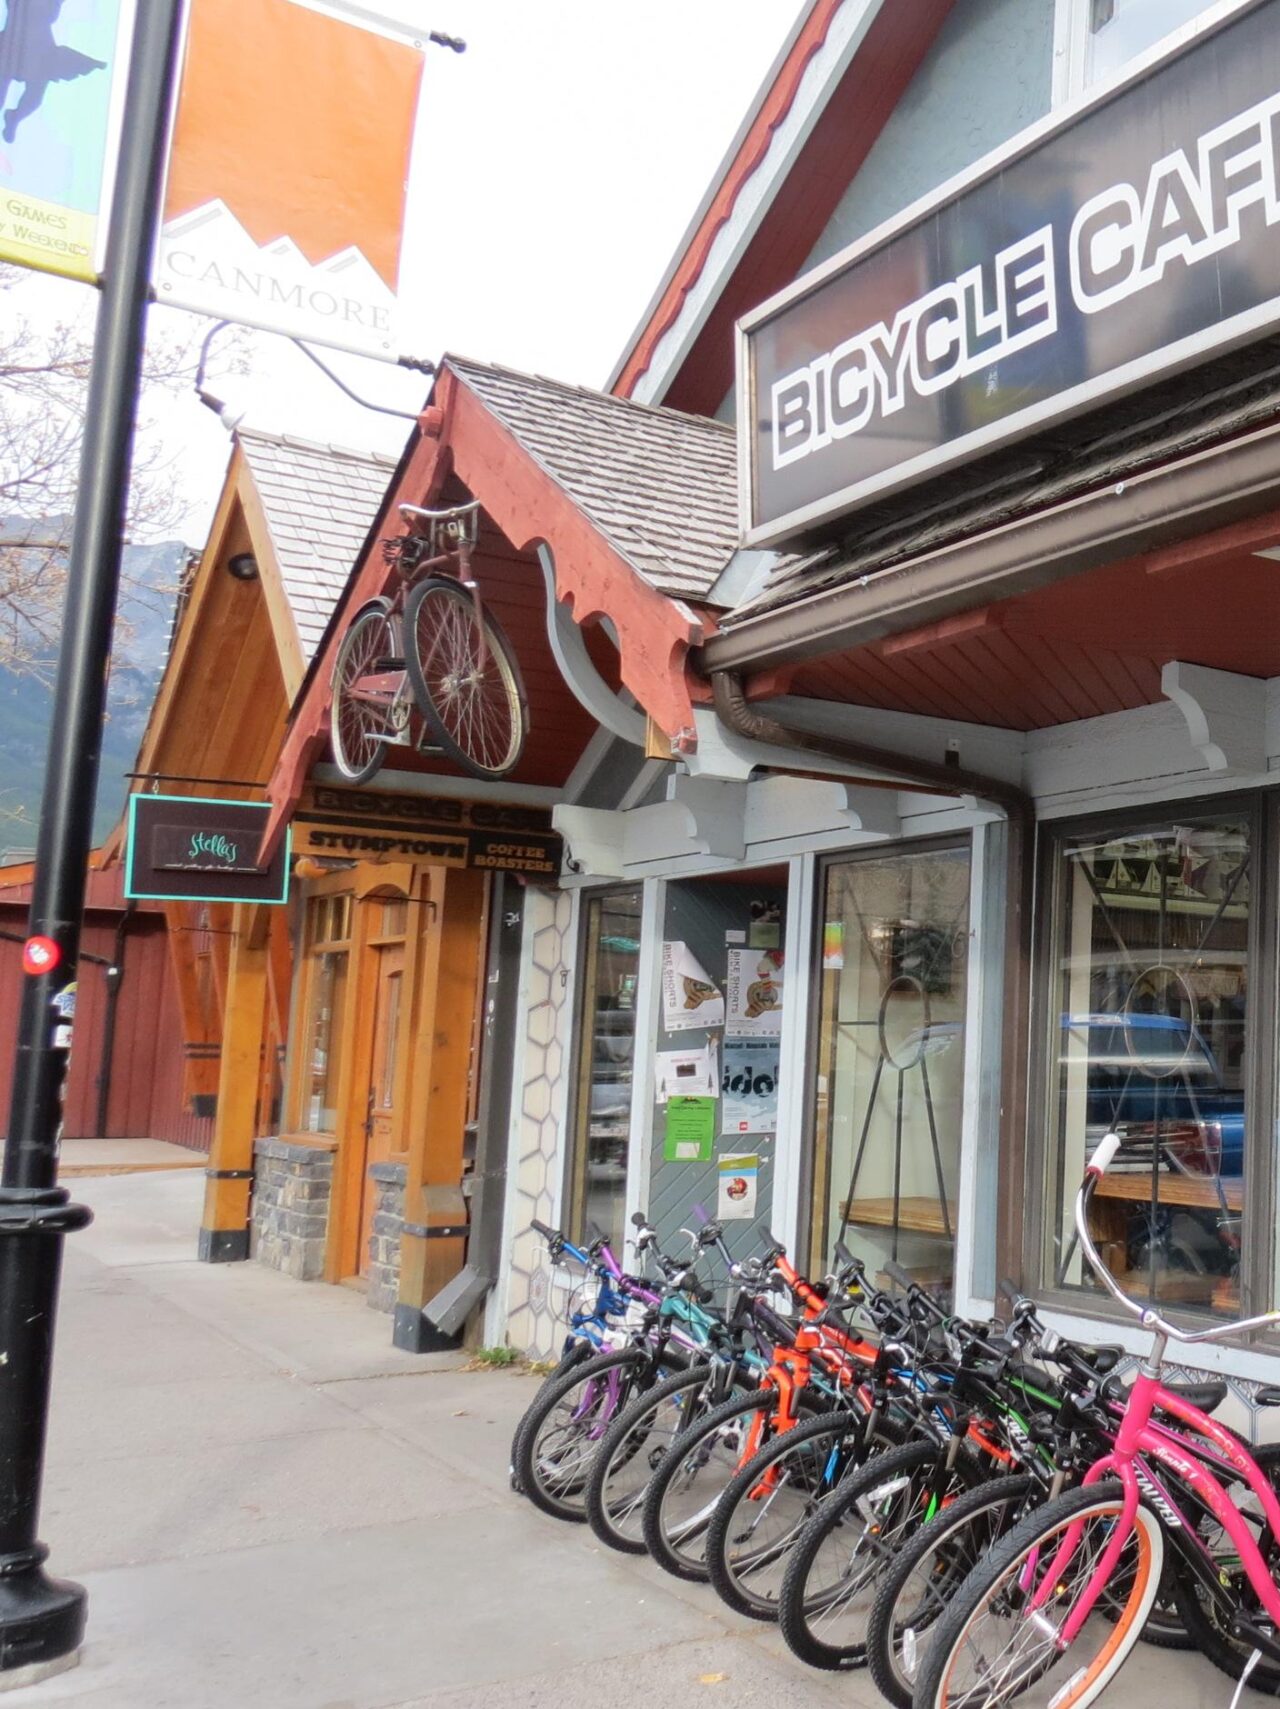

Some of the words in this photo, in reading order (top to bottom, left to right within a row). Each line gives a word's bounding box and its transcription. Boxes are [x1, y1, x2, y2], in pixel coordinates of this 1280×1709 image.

[166, 249, 391, 332] CANMORE
[771, 222, 1058, 471] BICYCLE
[308, 830, 465, 860] STUMPTOWN
[487, 842, 545, 858] COFFEE
[733, 951, 741, 973] BIKE
[731, 975, 740, 1014] SHORTS
